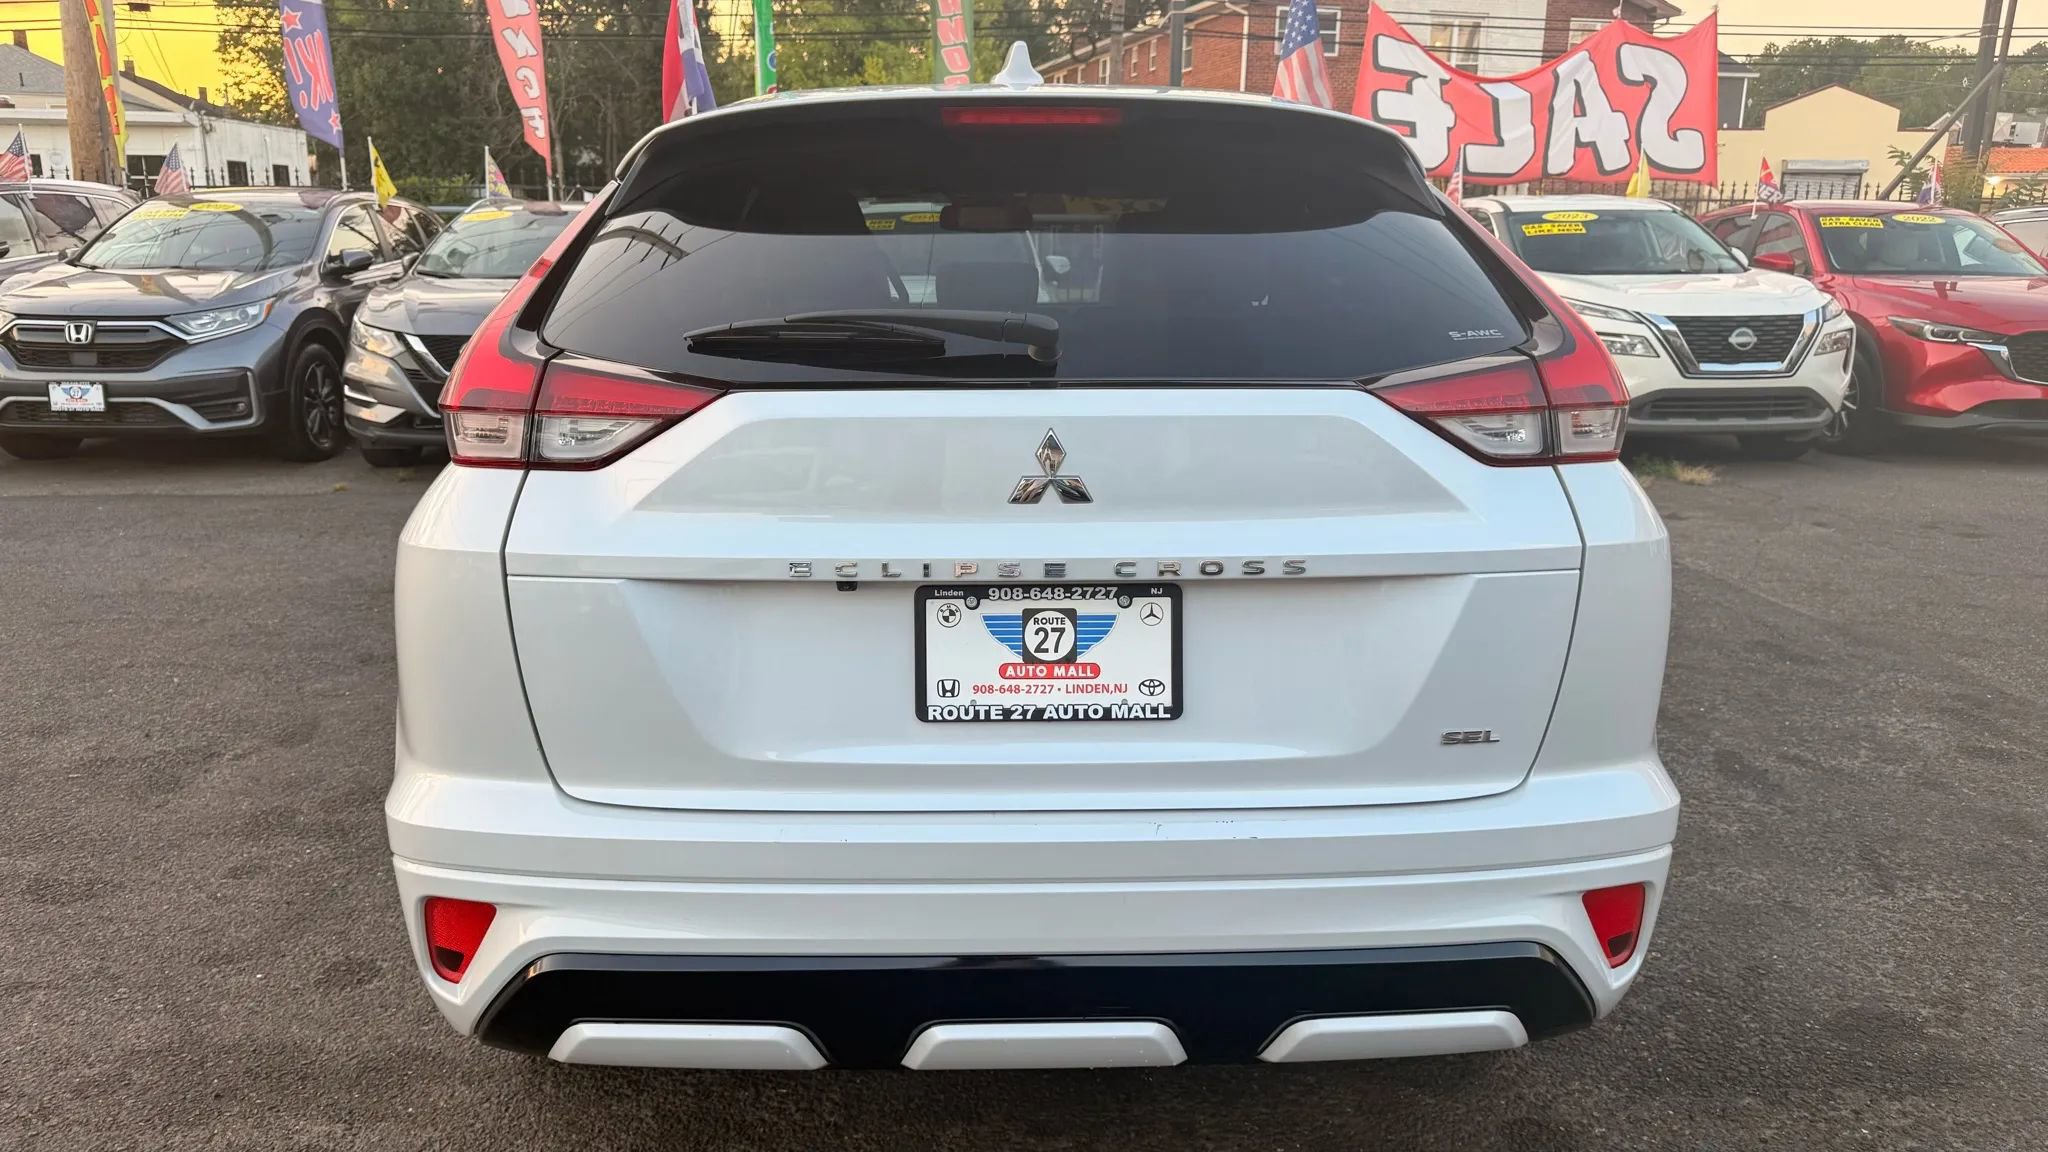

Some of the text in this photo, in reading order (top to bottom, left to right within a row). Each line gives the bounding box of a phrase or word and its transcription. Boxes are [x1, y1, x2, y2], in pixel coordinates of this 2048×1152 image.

[1448, 329, 1503, 338] S-AWC
[788, 559, 1307, 578] ECLIPSE CROSS
[934, 589, 964, 597] Linden
[988, 586, 1119, 601] 908-648-2727
[1150, 587, 1163, 595] NJ
[1033, 617, 1066, 626] ROUTE
[1033, 627, 1066, 654] 27
[1005, 665, 1095, 678] AUTO MALL
[972, 684, 1054, 695] 908-648-2727
[927, 703, 1171, 721] ROUTE 27 AUTO MALL
[1440, 729, 1501, 745] SEL
